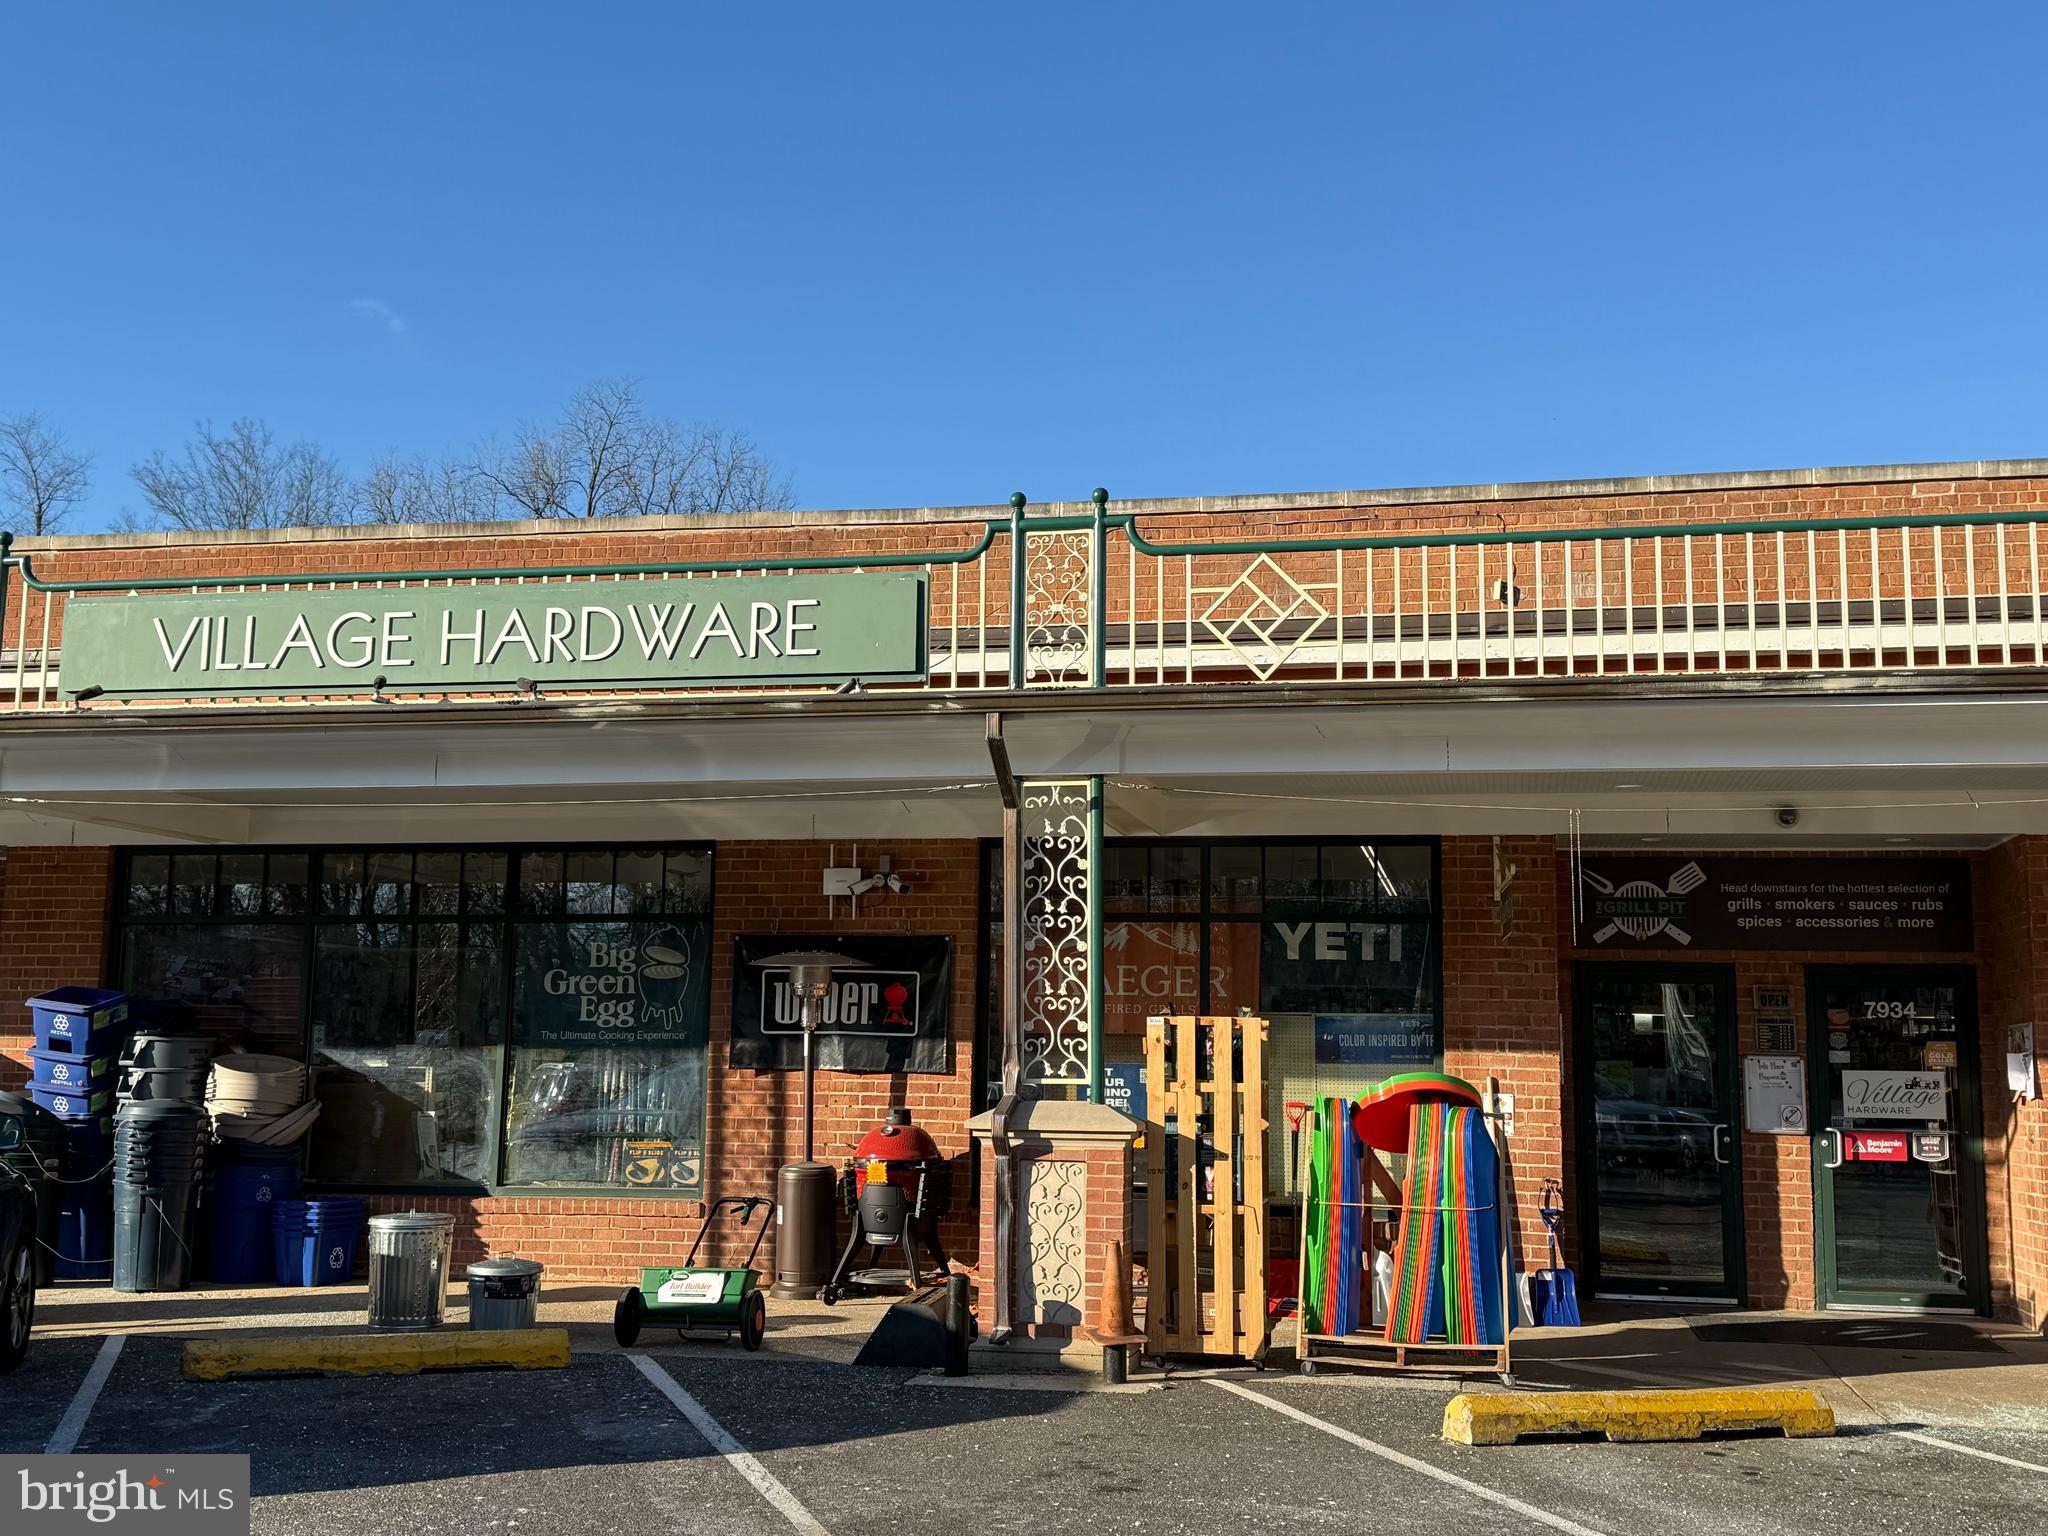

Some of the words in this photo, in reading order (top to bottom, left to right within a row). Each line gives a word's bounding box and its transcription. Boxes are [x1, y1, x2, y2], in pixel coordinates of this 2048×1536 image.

[153, 611, 415, 671] VILLAGE
[441, 600, 821, 665] HARDWARE
[1721, 883, 1748, 893] Head
[1750, 883, 1808, 893] downstairs
[1810, 883, 1825, 893] for
[1828, 883, 1844, 893] the
[1847, 883, 1885, 893] hottest
[1888, 883, 1935, 893] selection
[1938, 883, 1950, 893] of
[1604, 901, 1654, 914] GRILL
[1657, 901, 1686, 914] PIT
[1727, 898, 1762, 912] grills
[1775, 898, 1835, 910] smokers
[1848, 900, 1898, 911] sauces
[1911, 899, 1943, 911] rubs
[1736, 915, 1782, 929] spices
[1795, 915, 1879, 928] accessories
[1883, 916, 1893, 928] &
[1897, 918, 1934, 928] more
[1272, 922, 1402, 962] YETI
[589, 941, 636, 974] Big
[544, 968, 636, 995] Green
[773, 981, 878, 1025] wber
[1760, 994, 1788, 1007] OPEN
[578, 995, 635, 1028] Egg
[1104, 1003, 1142, 1014] FIRED
[1863, 1001, 1917, 1019] 7934
[50, 1029, 73, 1038] RECYCLE
[540, 1031, 557, 1040] The
[560, 1031, 596, 1040] Ultimate
[598, 1031, 635, 1043] Cooking
[637, 1031, 686, 1043] Experience
[1338, 1034, 1365, 1047] COLOR
[1368, 1034, 1408, 1047] INSPIRED
[1411, 1034, 1421, 1047] BY
[1847, 1078, 1942, 1109] Village
[1847, 1105, 1912, 1115] HARDWARE
[1866, 1139, 1903, 1148] Benjamin
[1866, 1146, 1893, 1154] Moore
[670, 1282, 683, 1290] Turf
[685, 1282, 712, 1290] Builder
